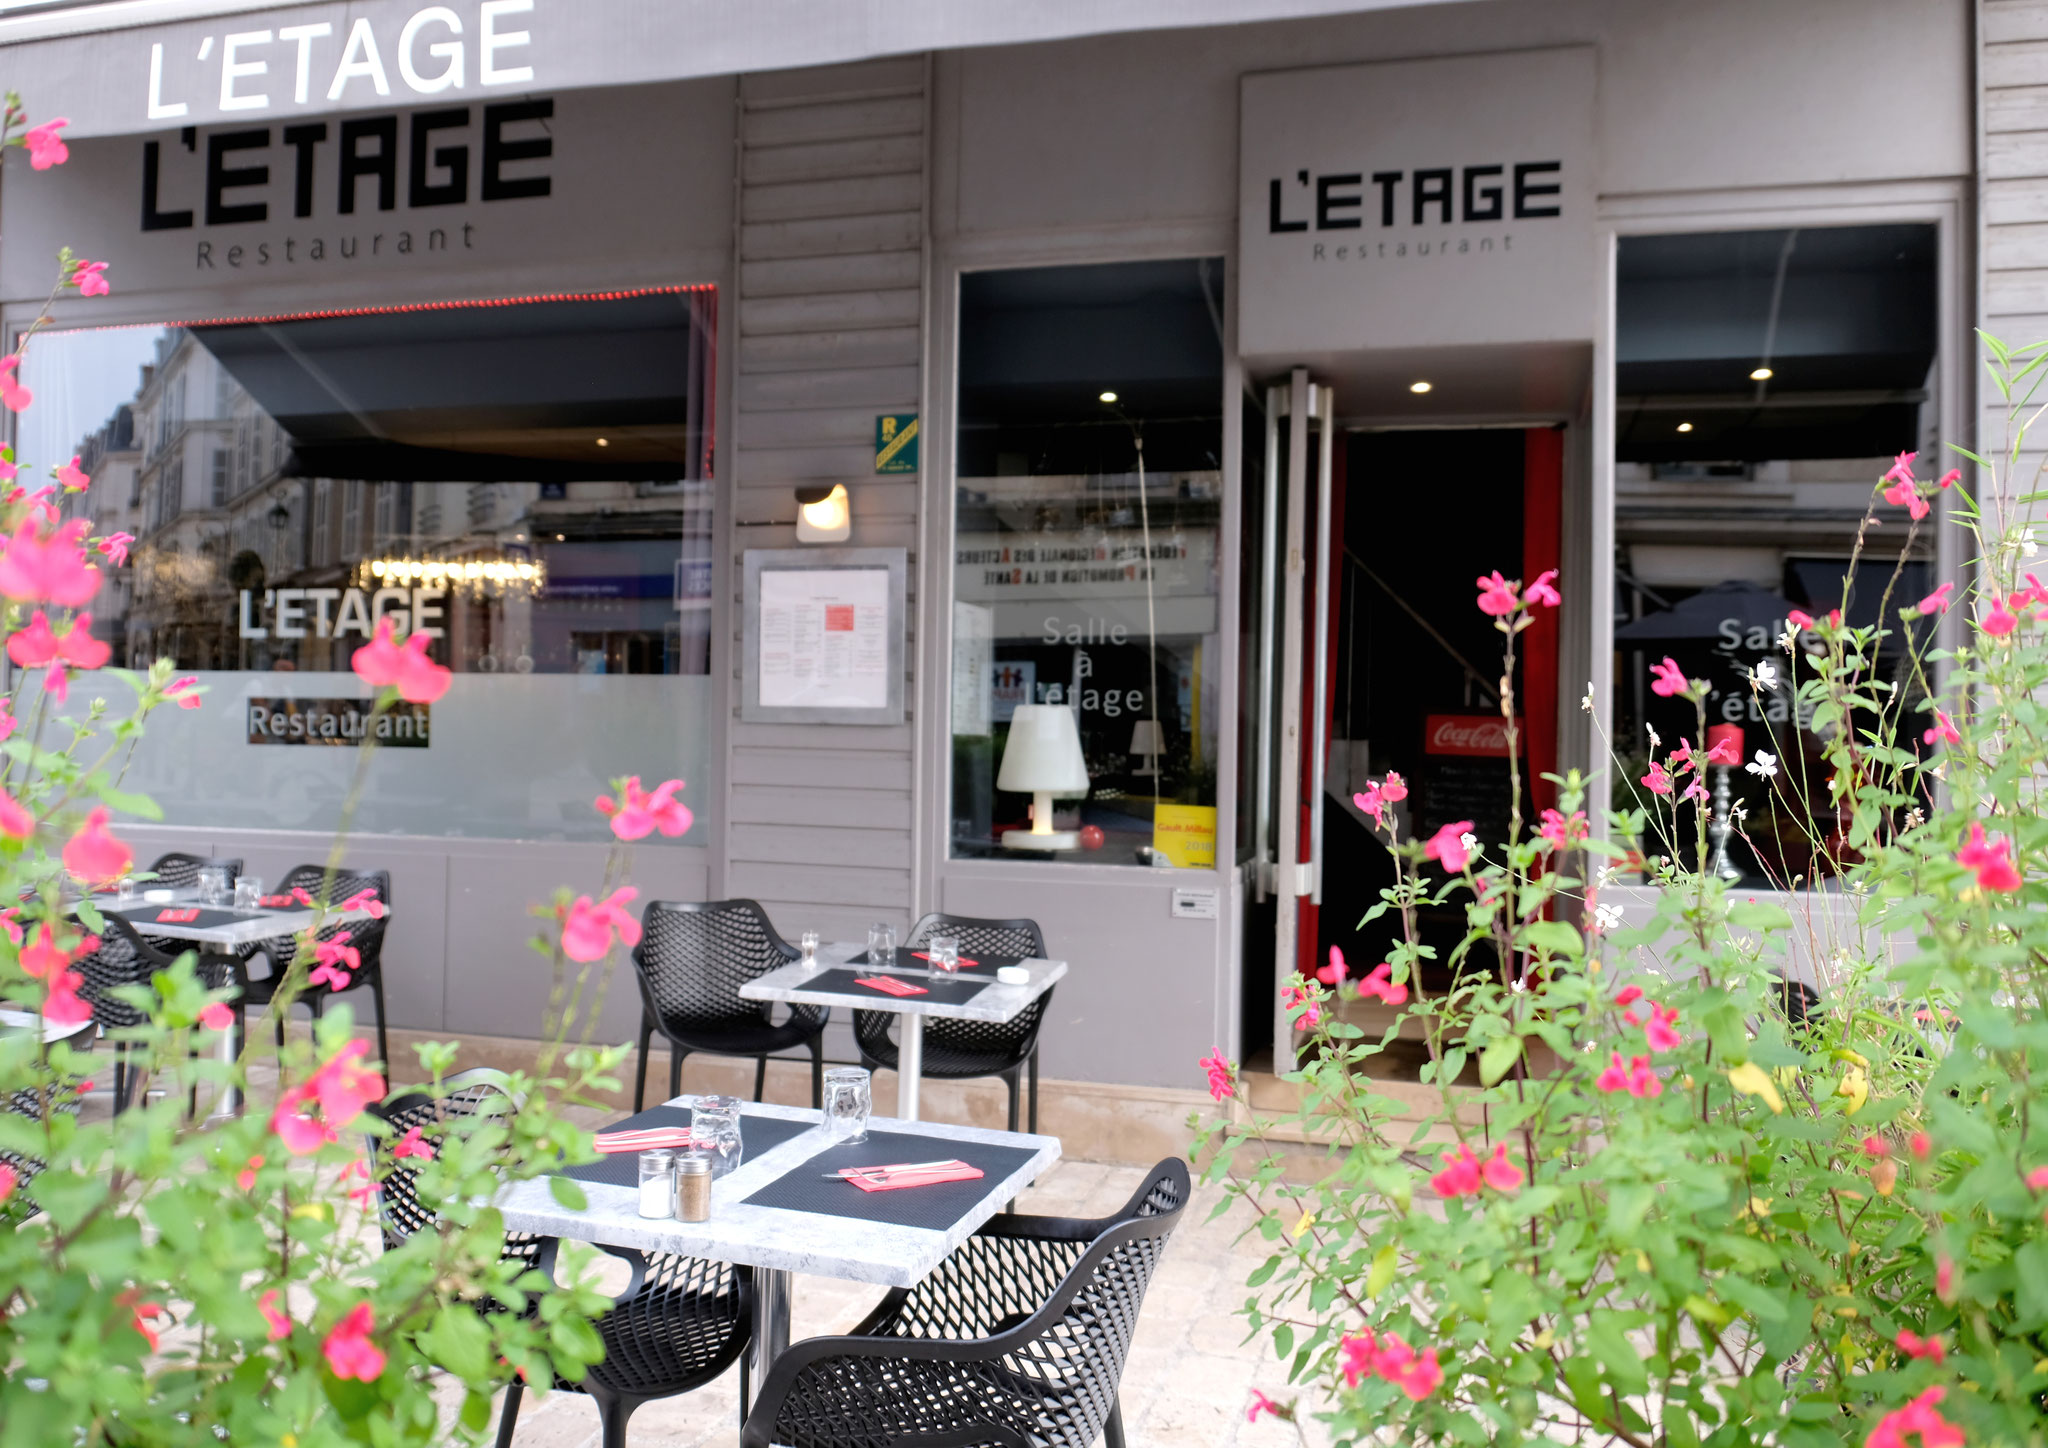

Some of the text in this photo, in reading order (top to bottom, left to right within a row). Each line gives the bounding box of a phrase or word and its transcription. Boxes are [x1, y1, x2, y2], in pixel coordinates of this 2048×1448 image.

[147, 0, 535, 119] L'ETAGE
[141, 97, 555, 231] L'ETAGE
[1269, 160, 1562, 233] L'ETAGE
[197, 221, 475, 269] Restaurant
[1312, 234, 1514, 262] Restaurant
[239, 588, 446, 639] L'ETAGE
[1043, 617, 1128, 645] Salle
[1718, 618, 1824, 650] Sale
[250, 705, 428, 739] Restaurant
